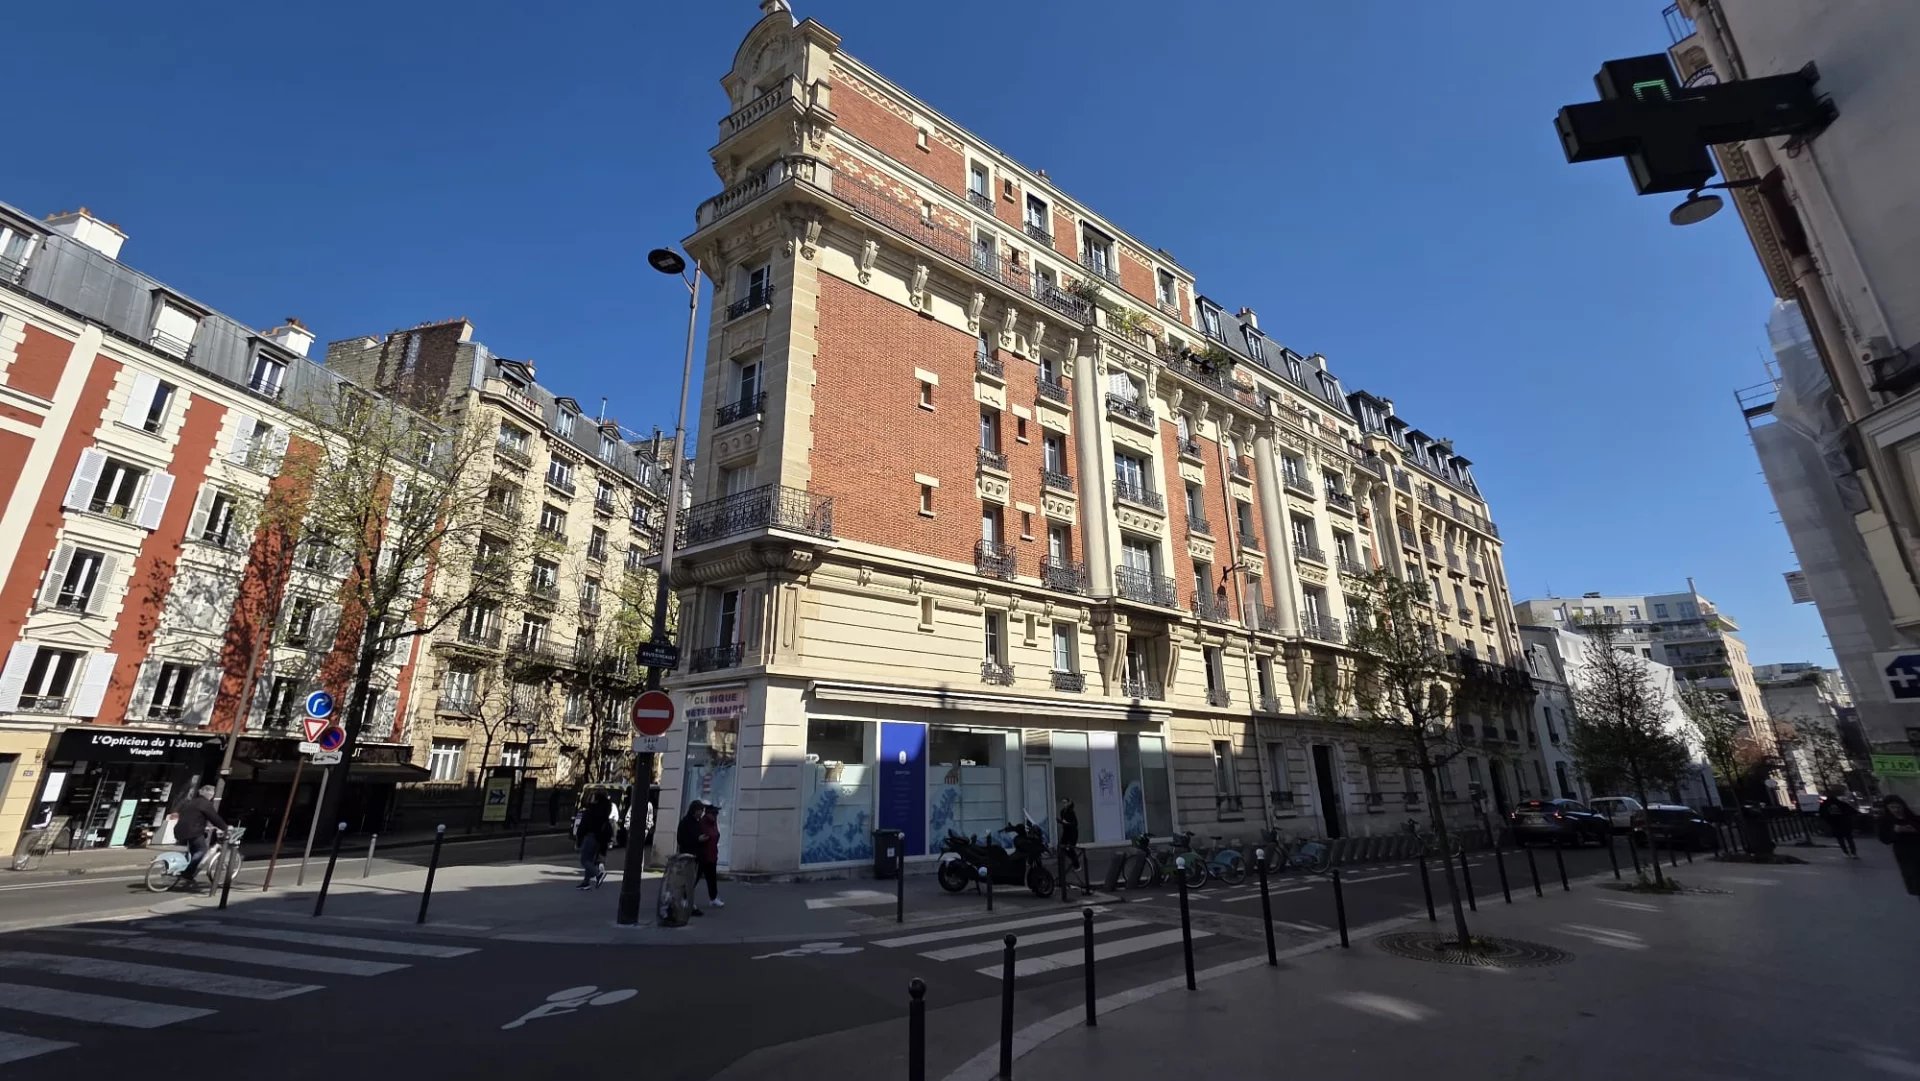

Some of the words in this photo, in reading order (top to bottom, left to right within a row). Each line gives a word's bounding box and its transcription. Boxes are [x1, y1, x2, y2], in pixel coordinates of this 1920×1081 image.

[694, 693, 737, 704] CLINIQUE
[91, 735, 148, 747] L'Opticien
[151, 737, 165, 747] du
[169, 739, 203, 748] 13ème
[130, 748, 164, 757] Visagiste
